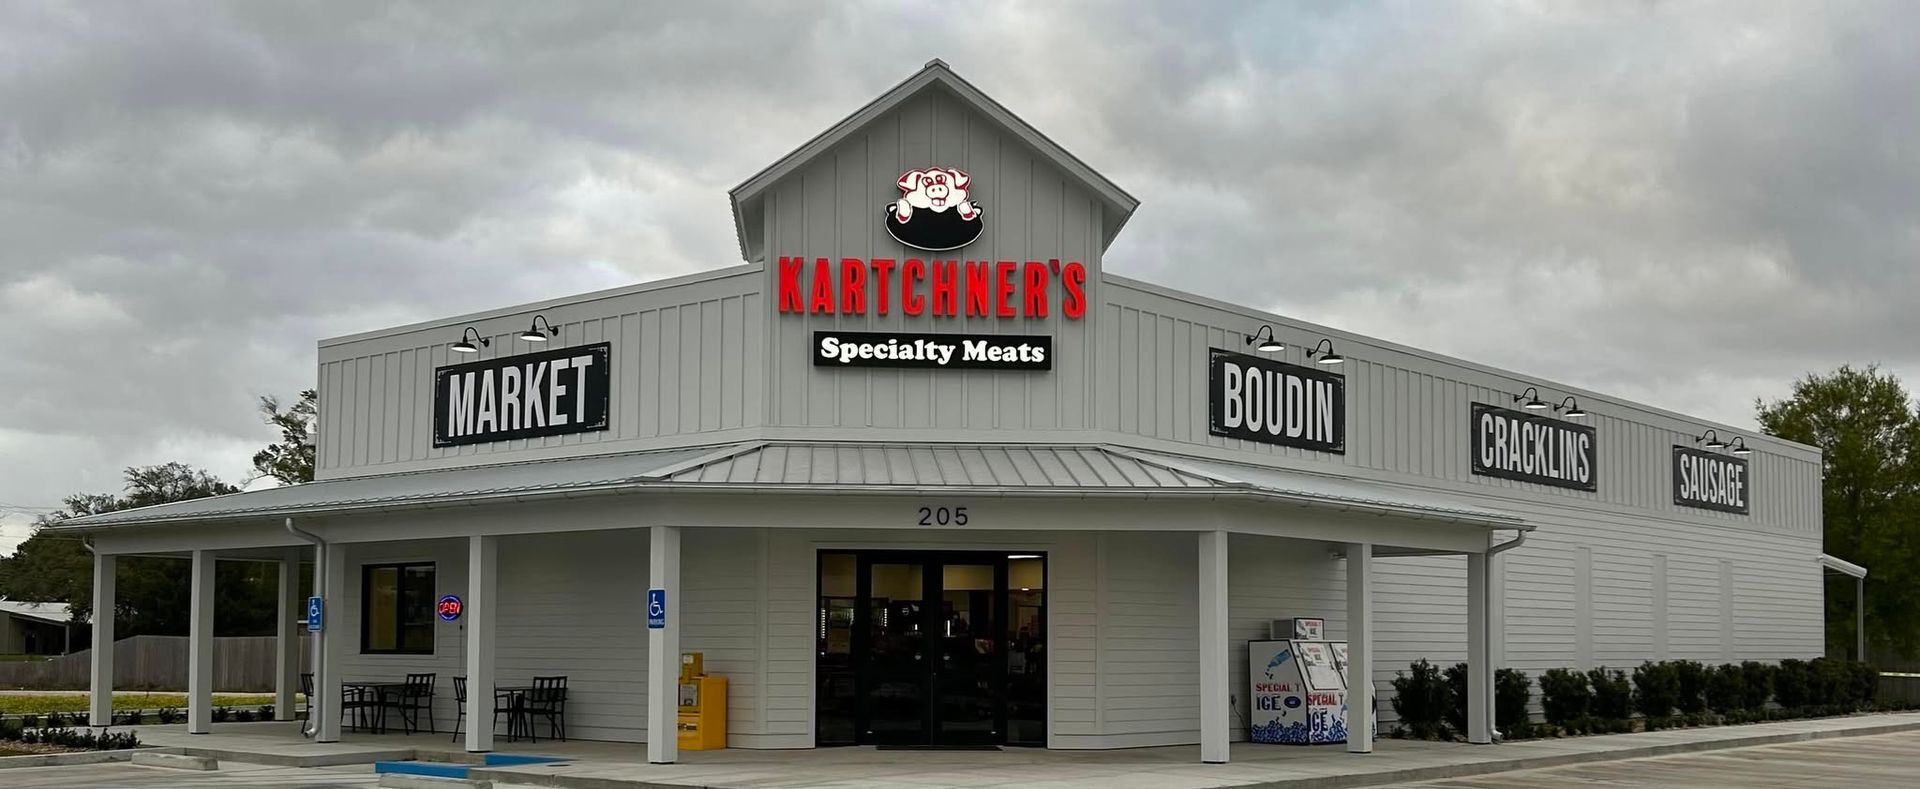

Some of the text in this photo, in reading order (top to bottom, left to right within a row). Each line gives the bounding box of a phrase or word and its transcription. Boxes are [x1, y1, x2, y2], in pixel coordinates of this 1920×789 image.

[778, 256, 1087, 320] KARTCHNER'S
[820, 337, 1045, 365] Specialty Meats
[448, 354, 594, 438] MARKET
[1223, 361, 1333, 444] BOUDIN
[1481, 413, 1590, 484] CRACKLINS
[1680, 453, 1744, 508] SAUSAGE
[918, 507, 968, 526] 205
[1256, 682, 1300, 692] SPECIAL T
[1256, 695, 1282, 710] ICE
[1307, 693, 1337, 706] SPECIAL
[1339, 694, 1344, 706] T
